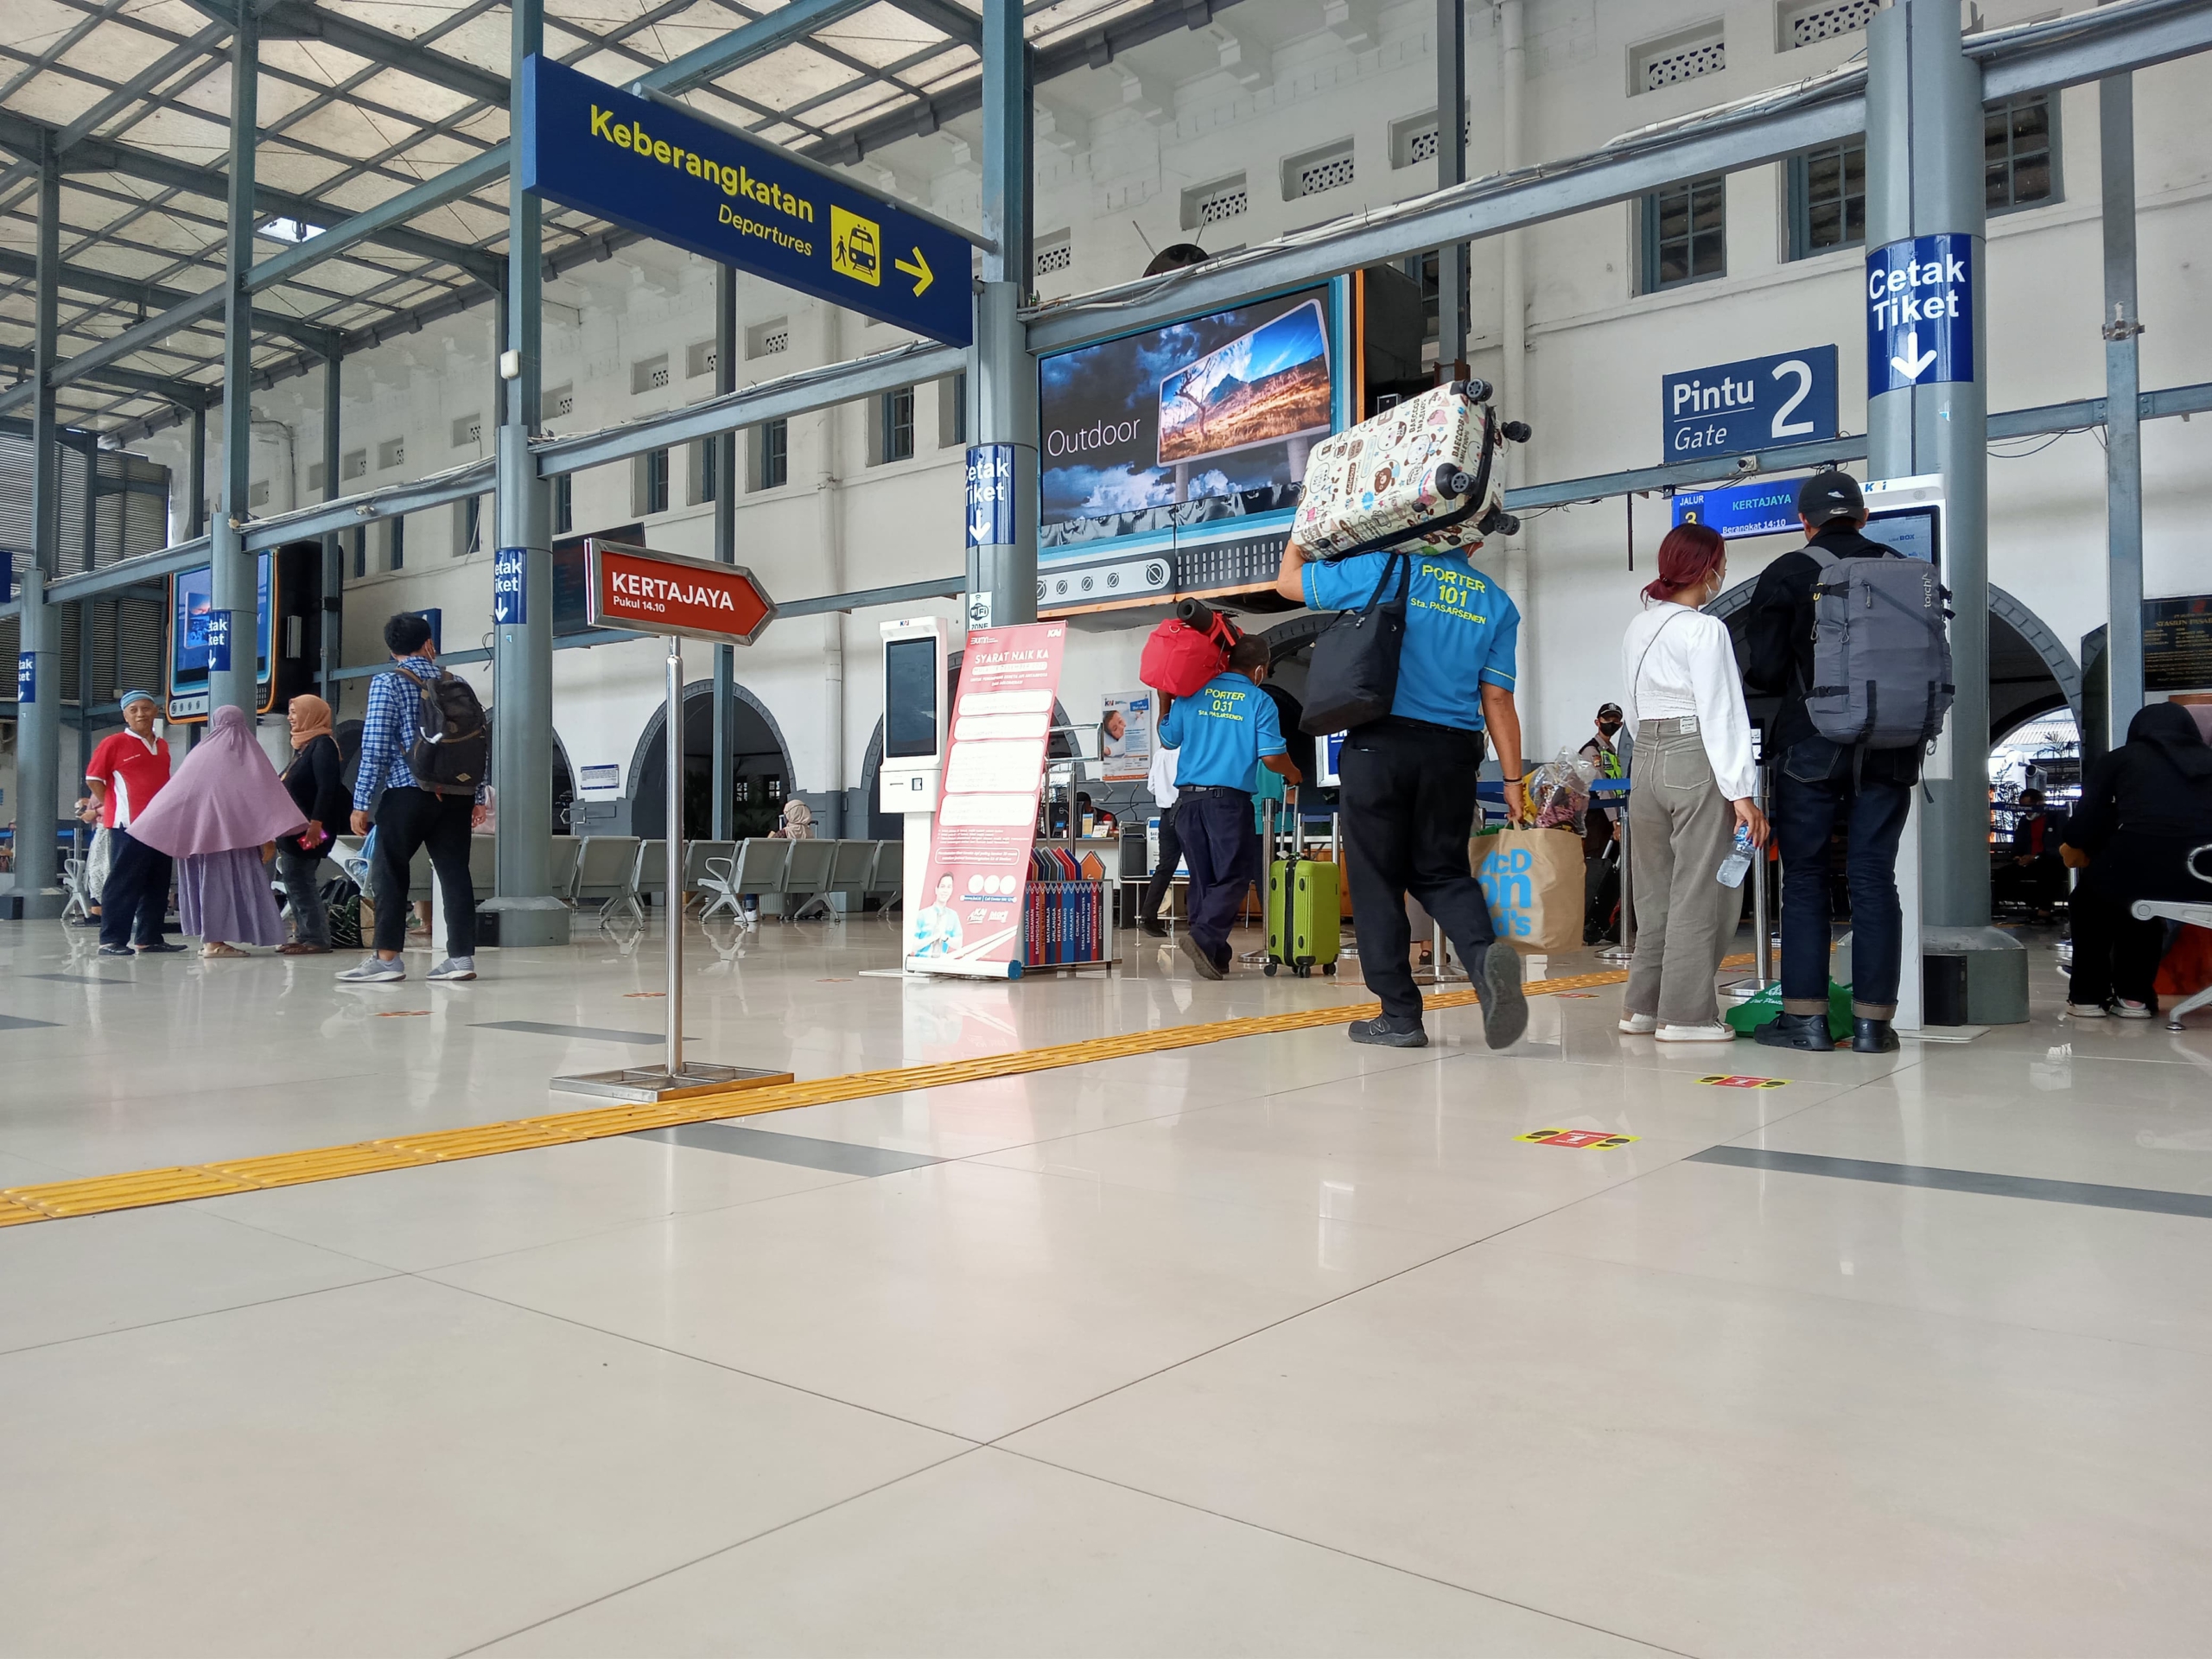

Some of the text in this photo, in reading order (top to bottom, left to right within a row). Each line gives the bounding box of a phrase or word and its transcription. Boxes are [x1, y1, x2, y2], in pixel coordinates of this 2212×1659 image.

[590, 104, 814, 223] Keberangkatan
[718, 203, 812, 257] Departures
[1869, 253, 1966, 300] Cetak
[1872, 289, 1960, 331] Tiket
[1674, 359, 1814, 438] Pintu 2
[1047, 419, 1141, 456] Outdoor
[1675, 424, 1727, 451] Gate
[1680, 495, 1704, 505] JALUR
[1732, 494, 1791, 511] KERTAJAYA
[1722, 519, 1786, 534] Berangkat 14:10
[495, 558, 522, 575] etak
[495, 576, 518, 594] iket
[612, 571, 734, 611] KERTAJAYA
[1422, 564, 1486, 594] PORTER
[613, 594, 665, 613] Pukul 14.10
[1439, 585, 1467, 607] 101
[1410, 598, 1486, 625] Sta. PASARSENEN
[208, 619, 227, 632] tak
[975, 649, 1049, 664] SYARAT NAIK KA
[1205, 688, 1246, 702] PORTER
[1212, 700, 1233, 712] 031
[1492, 910, 1531, 937] d's
